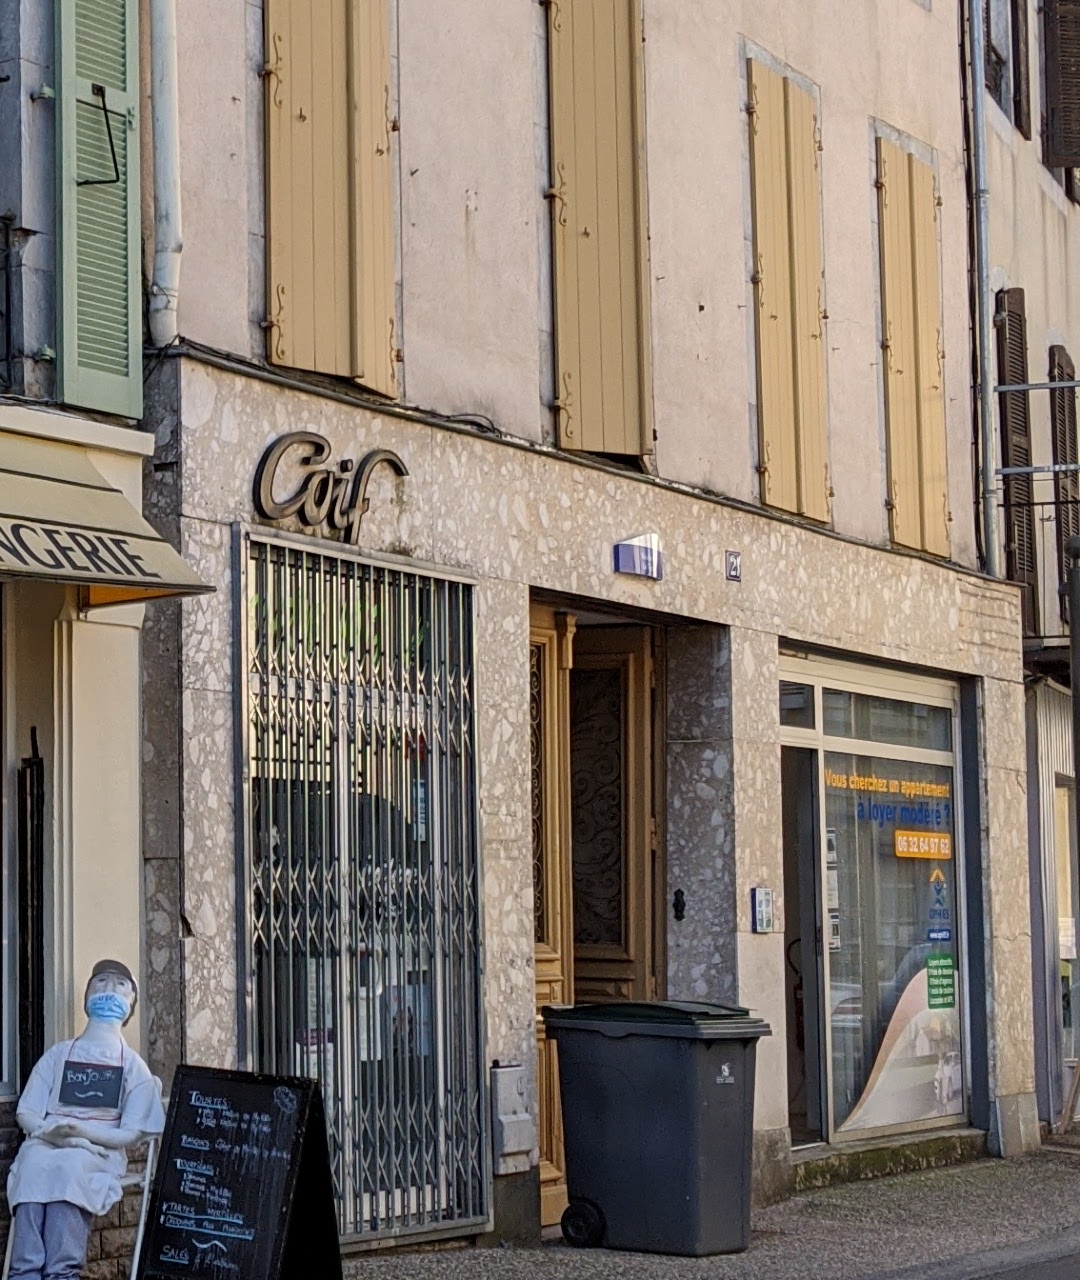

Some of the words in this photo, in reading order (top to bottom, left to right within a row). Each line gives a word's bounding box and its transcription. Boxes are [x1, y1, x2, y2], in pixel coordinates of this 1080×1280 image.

[252, 431, 410, 545] Coif
[825, 769, 847, 789] Vous
[849, 773, 887, 792] cherchez
[889, 780, 900, 793] un
[901, 781, 949, 798] appartement
[857, 796, 865, 819] à
[868, 797, 897, 828] loyer
[901, 800, 941, 825] modéré
[898, 836, 907, 852] 06
[909, 836, 918, 852] 32
[920, 837, 929, 853] 64
[930, 838, 939, 853] 97
[169, 1202, 196, 1215] TARTES
